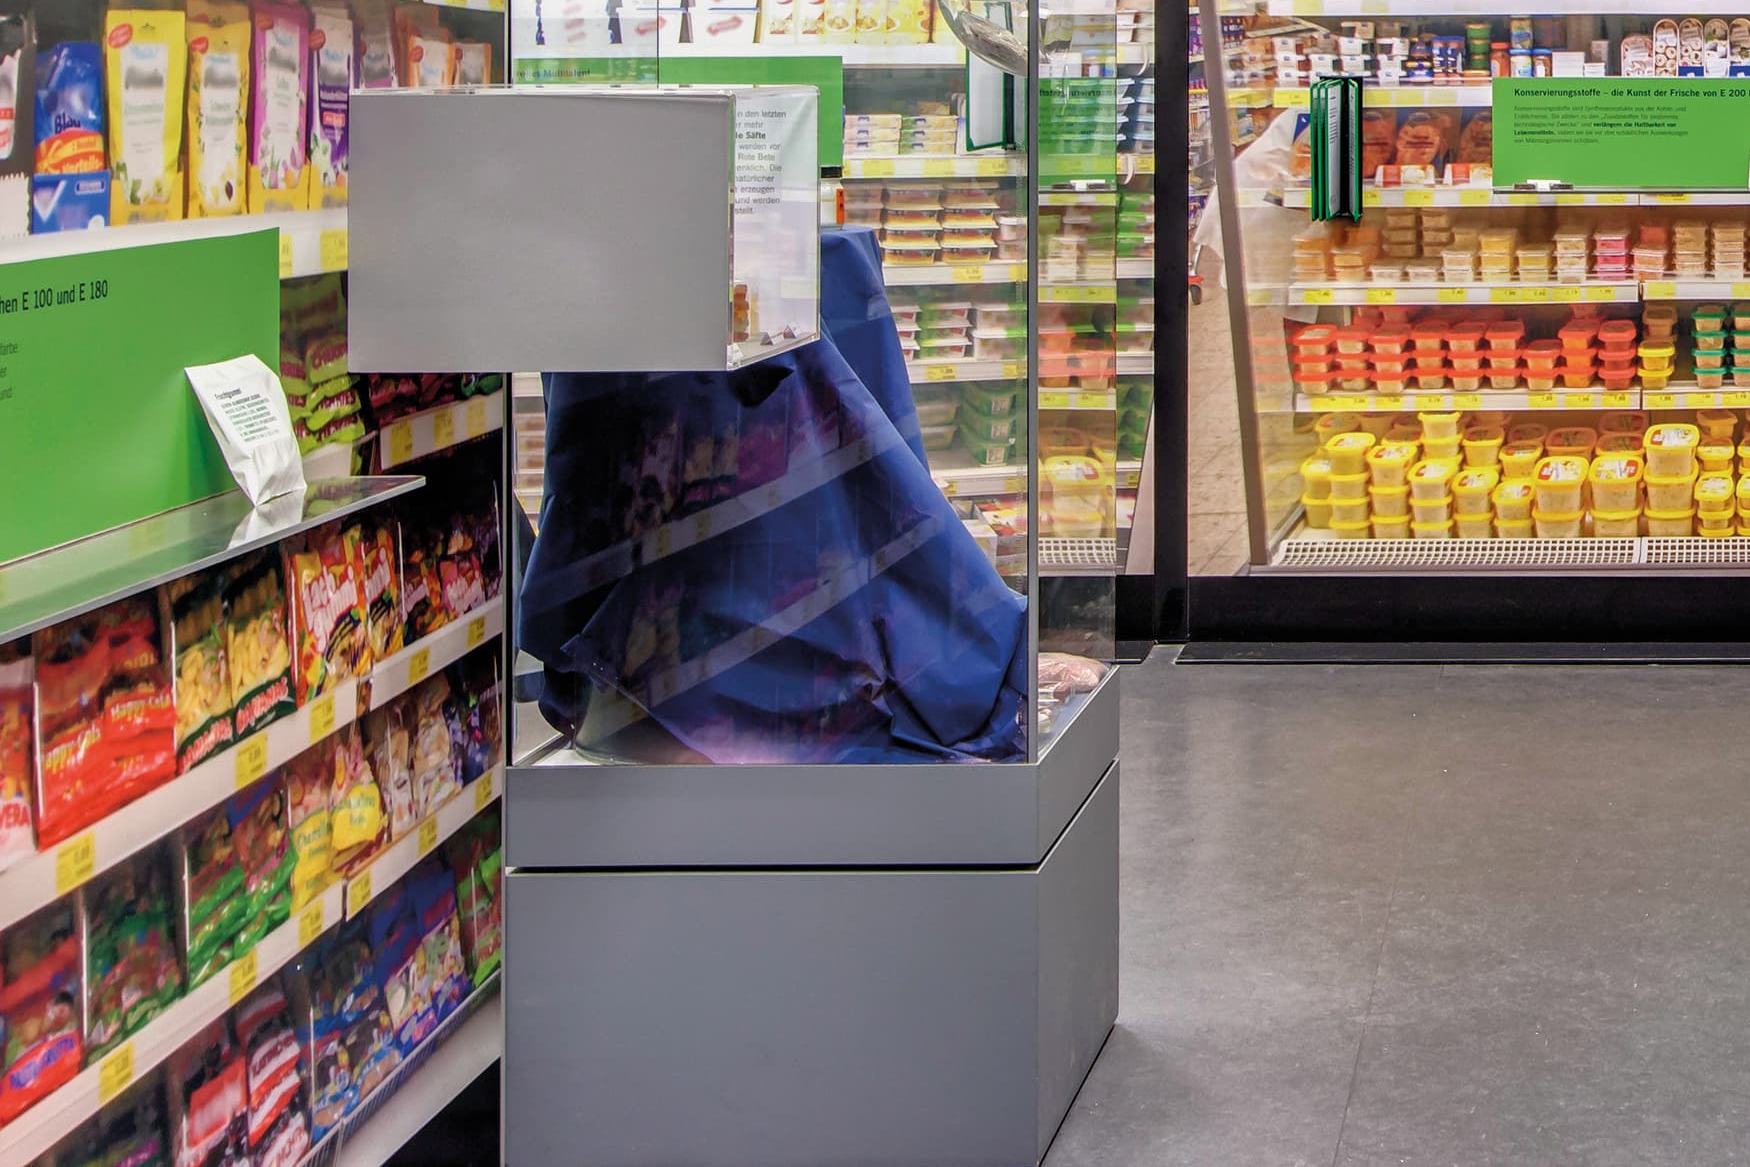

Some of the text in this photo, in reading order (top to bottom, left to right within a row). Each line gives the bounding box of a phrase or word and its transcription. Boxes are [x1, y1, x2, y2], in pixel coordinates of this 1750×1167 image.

[1514, 88, 1601, 98] Konservierungsstoffe
[1611, 89, 1624, 97] die
[1627, 89, 1650, 97] Kunst
[1653, 89, 1667, 97] der
[1670, 89, 1700, 97] Frische
[1729, 89, 1746, 97] 200
[744, 109, 787, 118] den letzten
[54, 111, 81, 134] Blau
[743, 120, 764, 129] mehr
[745, 131, 767, 140] Säfte
[739, 143, 767, 151] werden
[757, 153, 776, 161] Bete
[769, 164, 782, 172] Die
[740, 186, 775, 195] erzeugen
[22, 291, 29, 311] E
[34, 287, 53, 309] 100
[57, 285, 75, 305] und
[79, 283, 86, 302] E
[90, 279, 109, 299] 180
